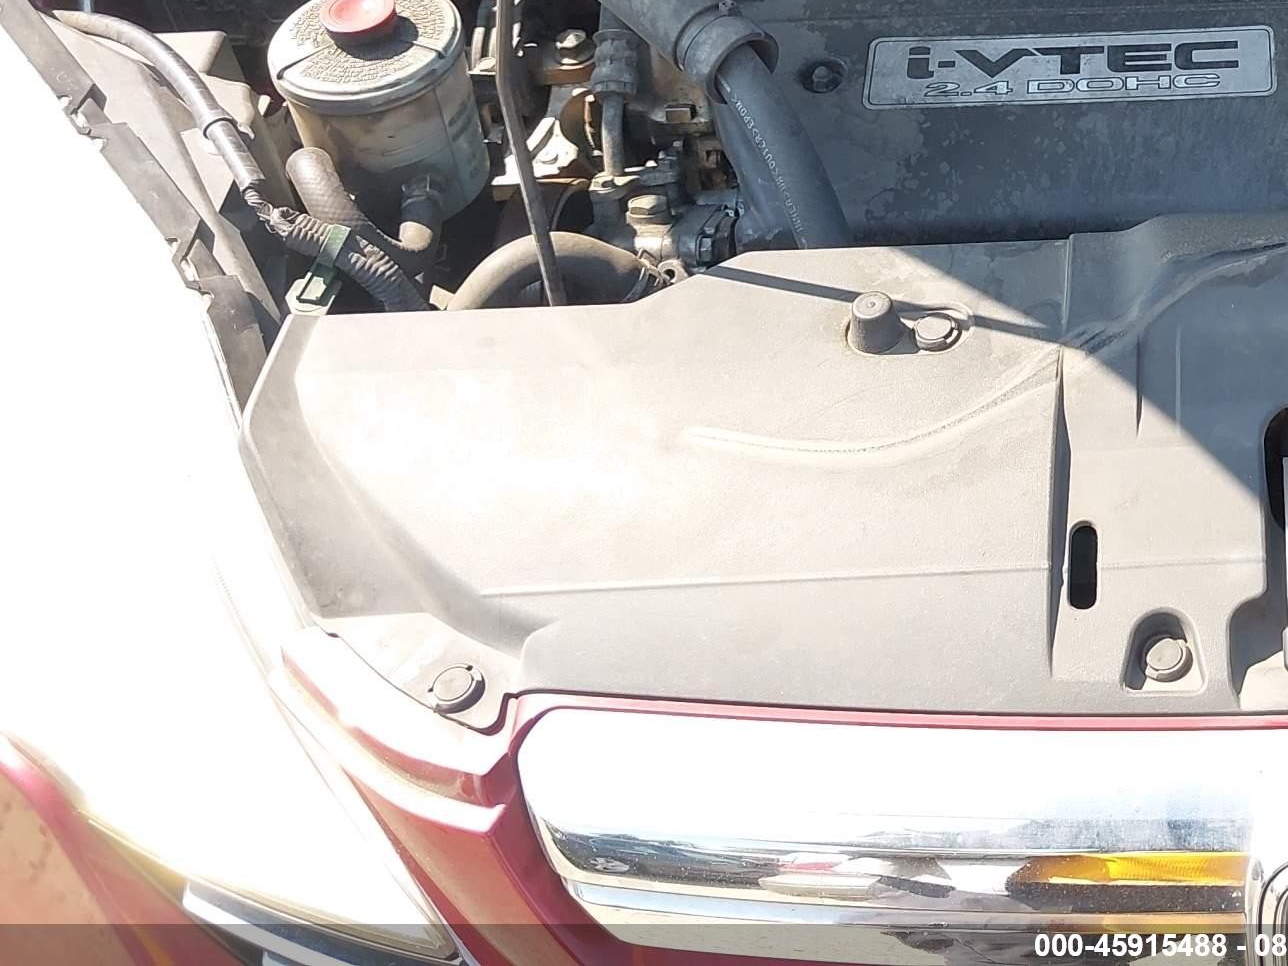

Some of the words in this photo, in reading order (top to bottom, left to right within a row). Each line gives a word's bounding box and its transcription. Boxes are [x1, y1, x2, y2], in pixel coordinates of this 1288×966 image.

[907, 40, 1239, 79] i-VTEC
[924, 79, 1013, 97] 2.4
[1026, 73, 1220, 94] DOHC
